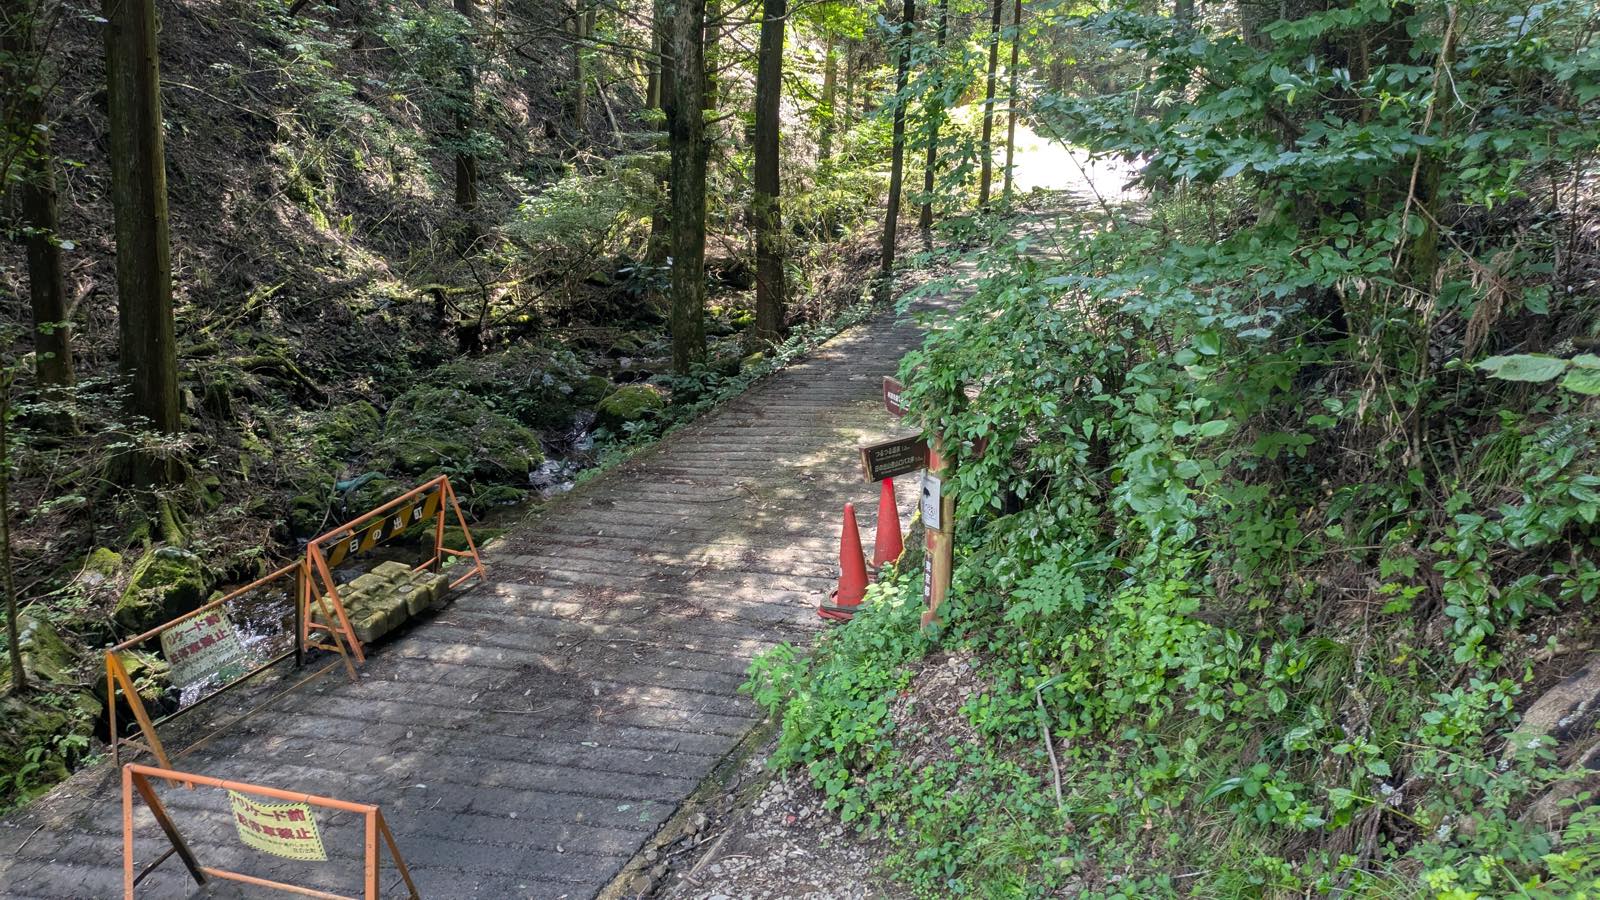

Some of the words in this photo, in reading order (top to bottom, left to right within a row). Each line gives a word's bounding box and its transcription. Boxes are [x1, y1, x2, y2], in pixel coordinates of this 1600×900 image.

[350, 507, 422, 552] 日の出町
[237, 812, 314, 839] 駐停車禁止
